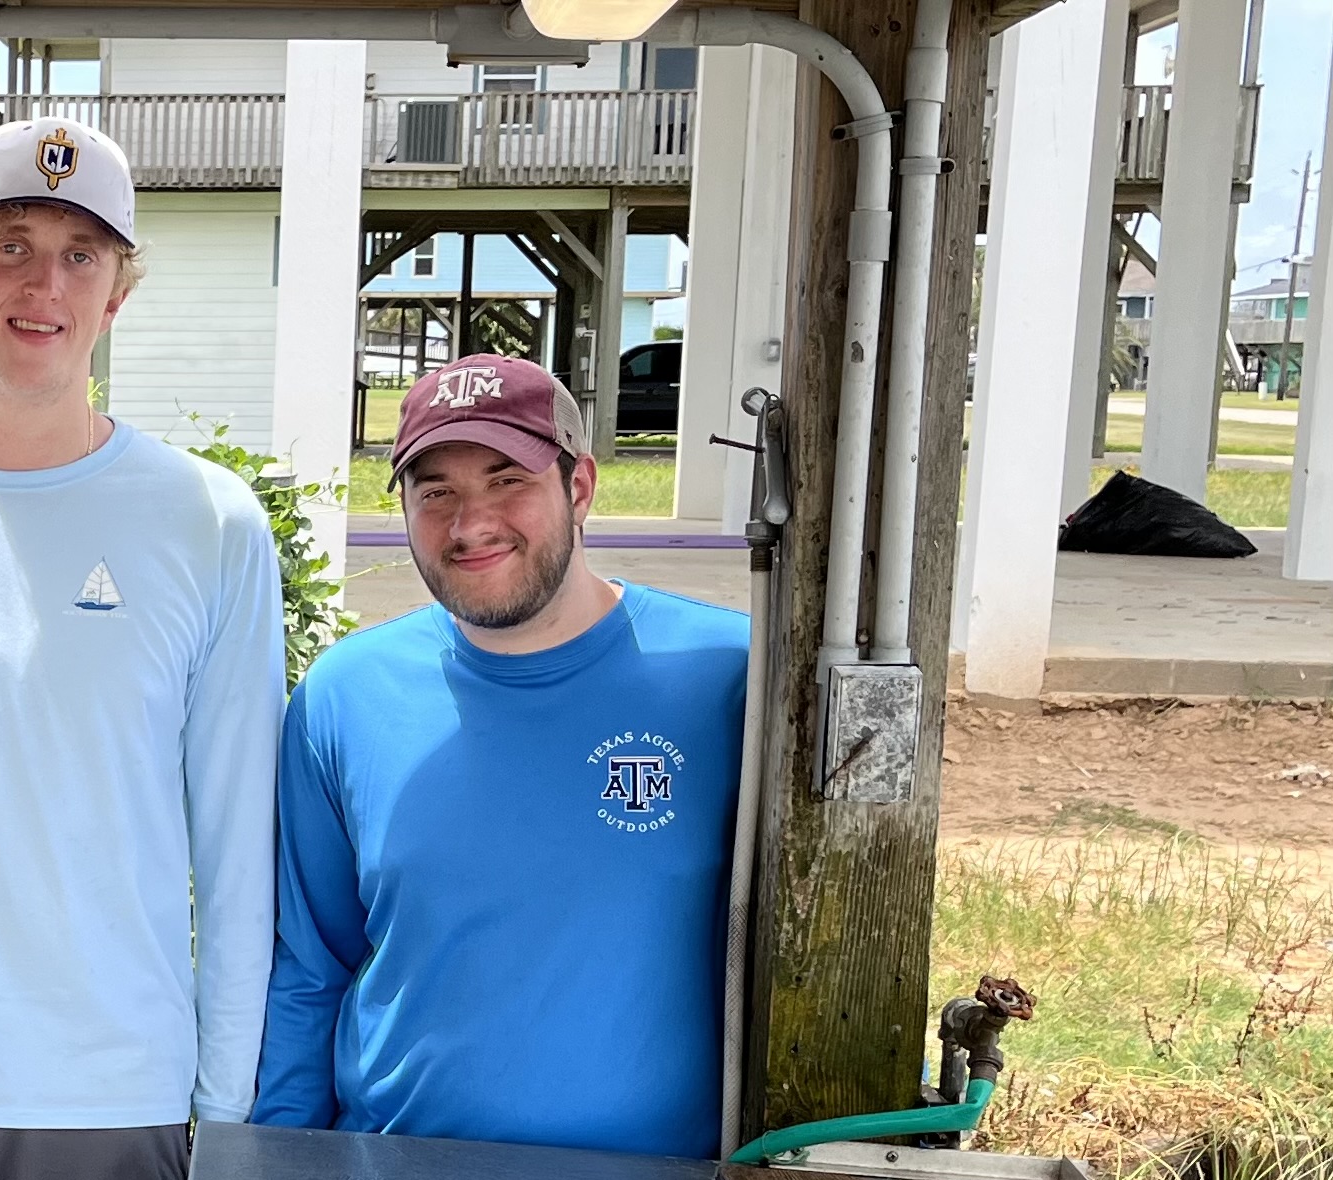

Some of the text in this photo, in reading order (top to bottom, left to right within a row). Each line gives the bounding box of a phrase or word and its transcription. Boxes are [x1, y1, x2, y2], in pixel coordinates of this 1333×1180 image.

[42, 143, 70, 173] CL
[586, 731, 685, 766] TEXAS AGGIE
[597, 808, 675, 833] OUTDOORS
